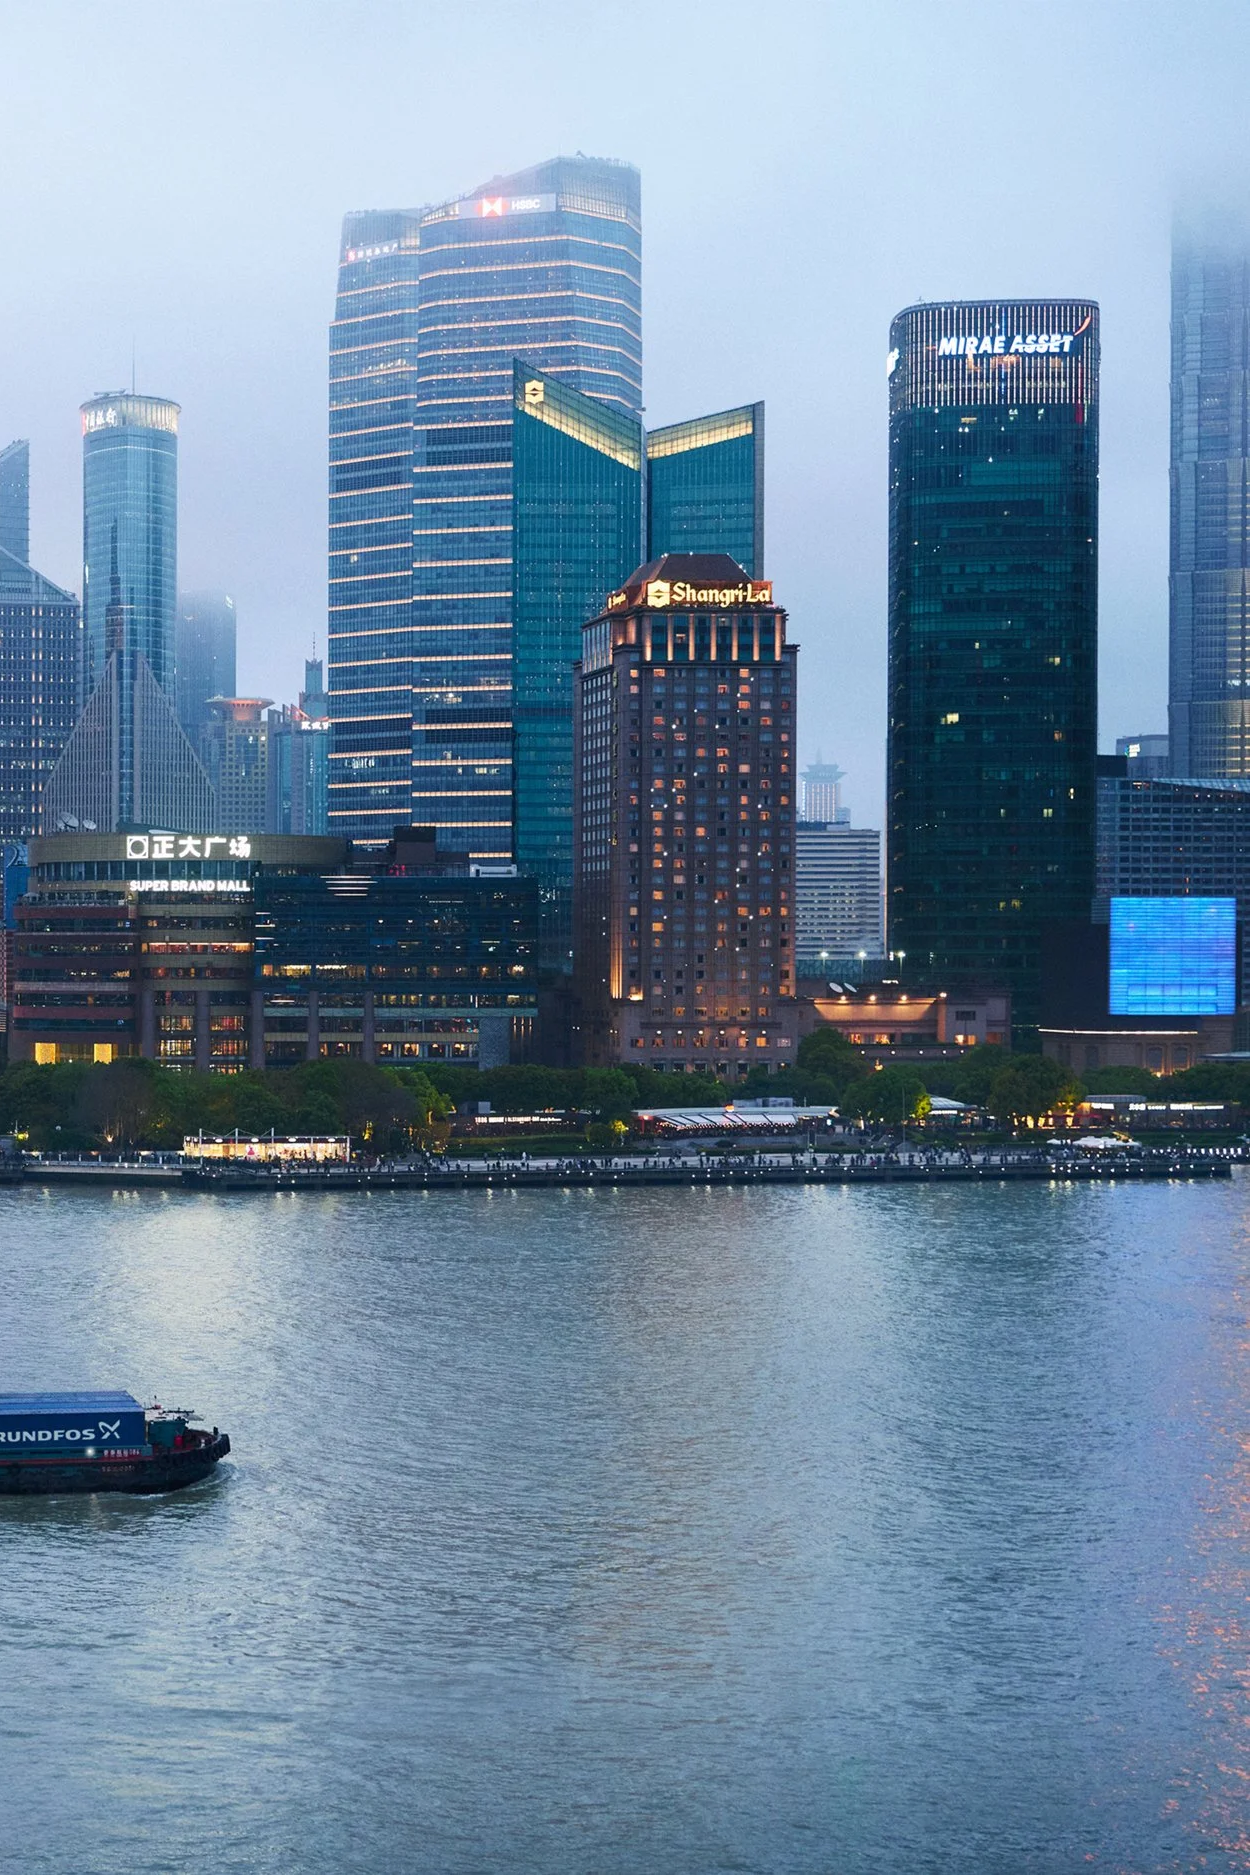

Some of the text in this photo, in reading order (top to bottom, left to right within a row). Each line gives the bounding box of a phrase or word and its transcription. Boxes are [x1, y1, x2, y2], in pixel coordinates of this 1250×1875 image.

[511, 199, 541, 210] HSBC
[938, 334, 1075, 356] MIRAE ASSET
[151, 835, 251, 859] 正大广场
[129, 880, 251, 892] SUPER BRAND MALL
